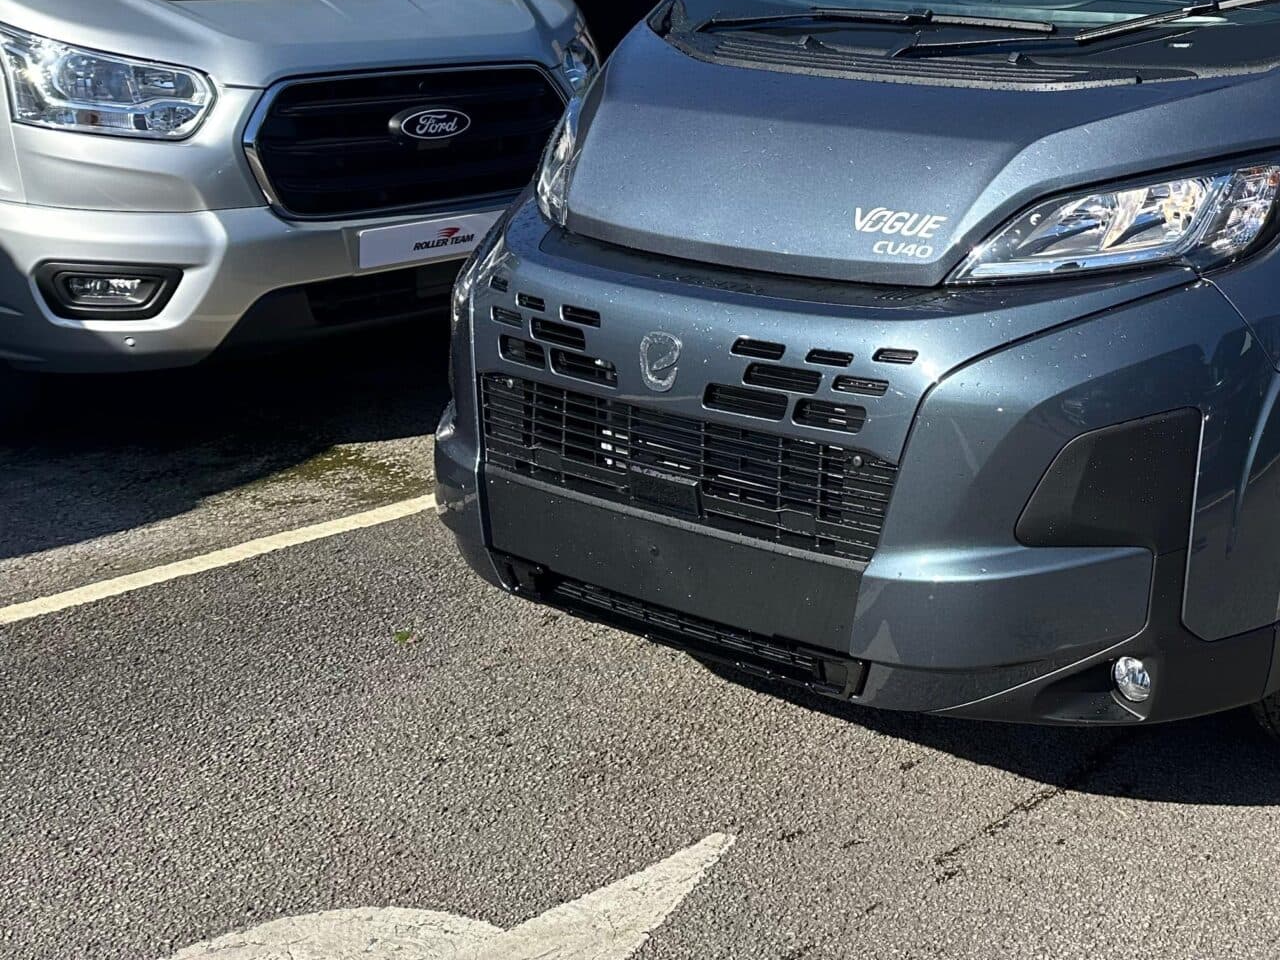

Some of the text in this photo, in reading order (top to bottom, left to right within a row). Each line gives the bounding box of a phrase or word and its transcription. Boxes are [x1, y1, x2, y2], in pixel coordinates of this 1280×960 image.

[415, 114, 459, 135] Ford
[854, 207, 948, 238] VOGUE
[413, 233, 475, 251] ROLLER TEAM
[872, 240, 934, 258] CU40
